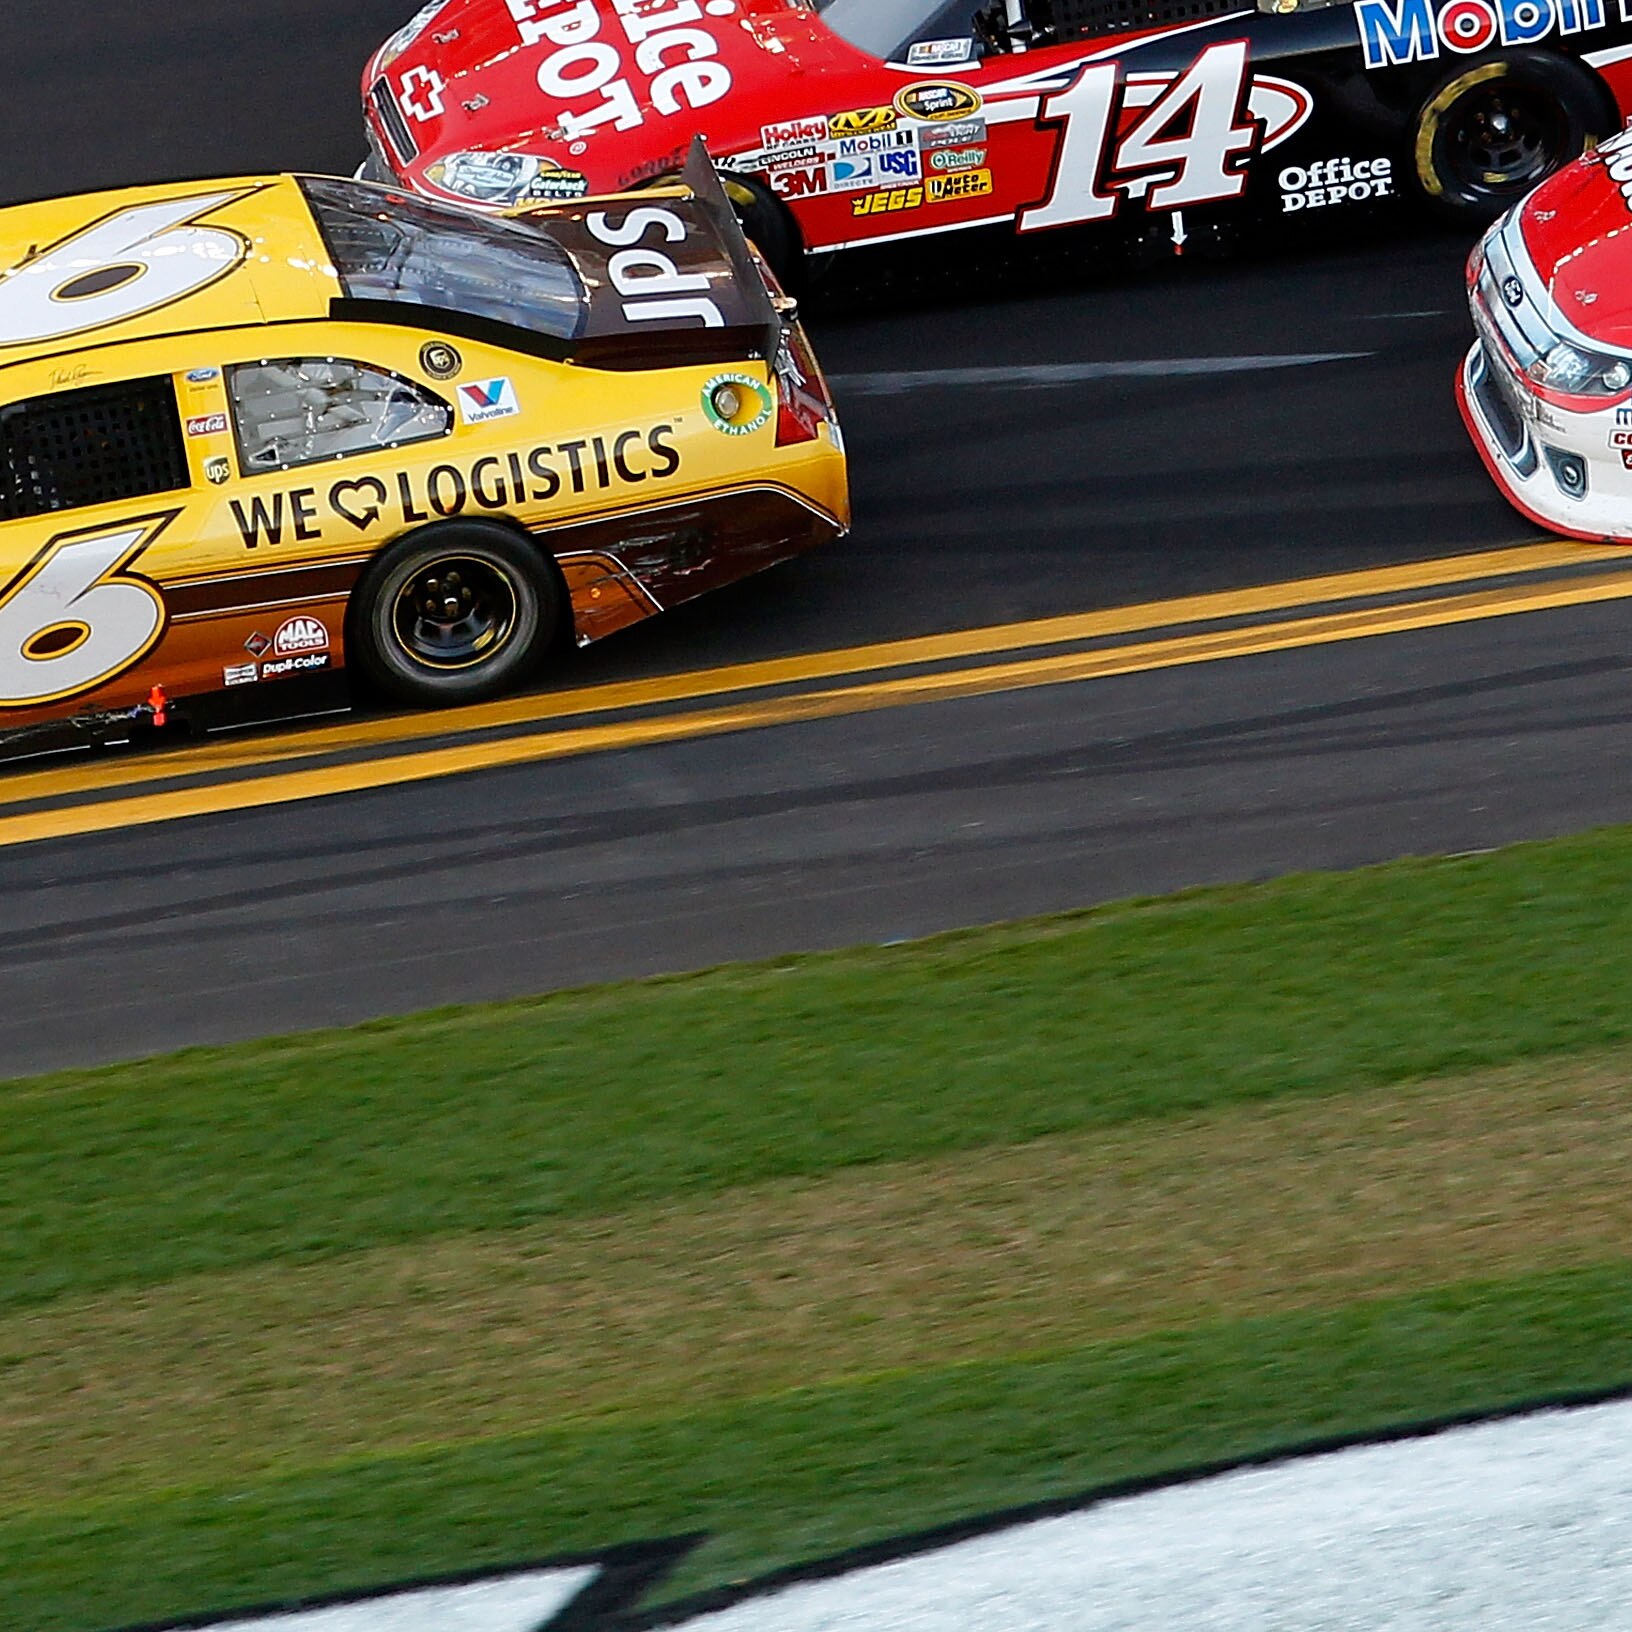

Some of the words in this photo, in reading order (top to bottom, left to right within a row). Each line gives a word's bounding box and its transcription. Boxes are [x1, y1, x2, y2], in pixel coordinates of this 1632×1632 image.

[924, 98, 954, 111] Sprint
[764, 121, 827, 145] Holley
[839, 133, 891, 155] Mobil
[1018, 40, 1266, 232] 14
[761, 147, 814, 165] LINCOLN
[773, 157, 820, 170] WELDERS
[879, 150, 918, 176] USG
[774, 166, 828, 198] 3M
[945, 174, 979, 186] Auto
[1278, 157, 1391, 191] Office
[853, 187, 924, 215] JEGS
[1281, 177, 1392, 212] DEPOT
[702, 374, 760, 398] AMERICAN
[469, 406, 513, 422] Valvoline
[714, 409, 772, 436] ETHANOL
[206, 465, 230, 483] ups
[228, 488, 322, 549] WE
[397, 424, 681, 522] LOGISTICS
[278, 620, 324, 644] MAC
[279, 637, 325, 650] TOOLS
[262, 654, 327, 674] Dupli-Color
